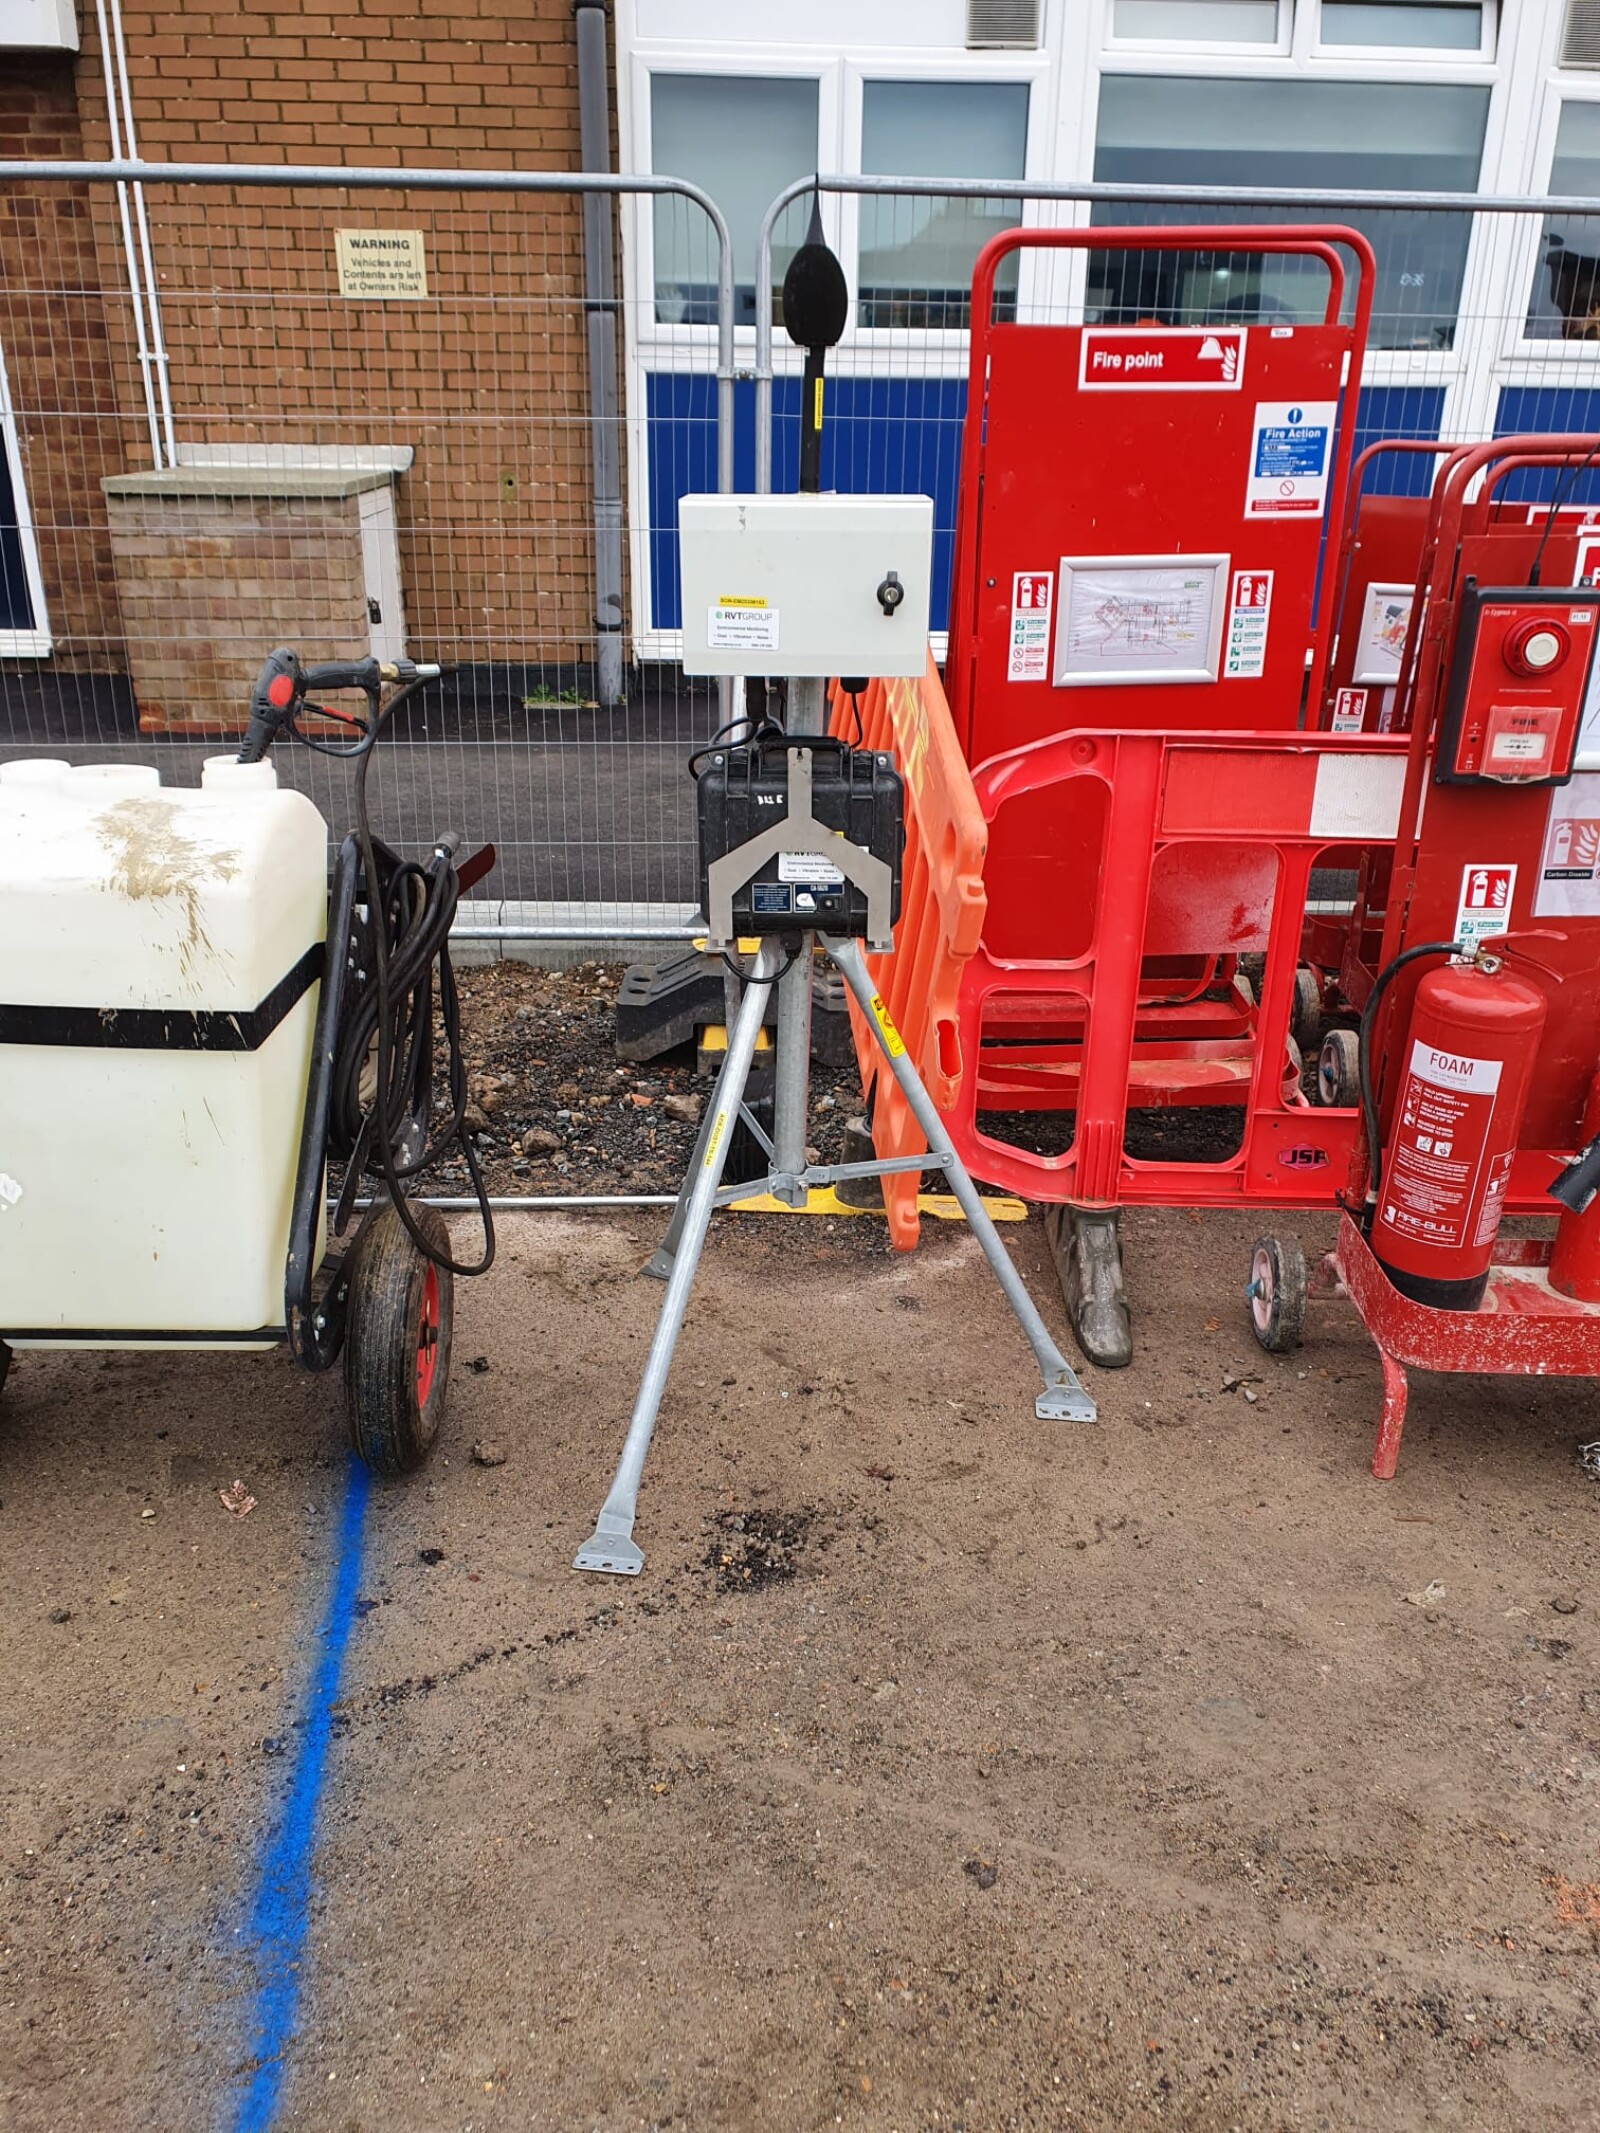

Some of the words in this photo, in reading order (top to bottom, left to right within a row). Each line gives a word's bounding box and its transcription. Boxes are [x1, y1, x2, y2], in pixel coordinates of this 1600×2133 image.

[349, 239, 410, 250] WARNING
[351, 258, 392, 268] Vehicles
[394, 259, 411, 268] and
[343, 269, 385, 279] Contents
[388, 271, 404, 279] are
[407, 271, 422, 280] left
[347, 282, 357, 290] at
[359, 282, 396, 291] Owners
[399, 283, 419, 291] Risk
[1093, 351, 1121, 368] Fire
[1124, 351, 1163, 372] point
[1265, 428, 1286, 438] Fire
[1288, 428, 1321, 438] Action
[724, 611, 772, 621] RVTGROUP
[1429, 1052, 1474, 1076] FOAM
[1397, 1211, 1457, 1234] FIRE-BULL
